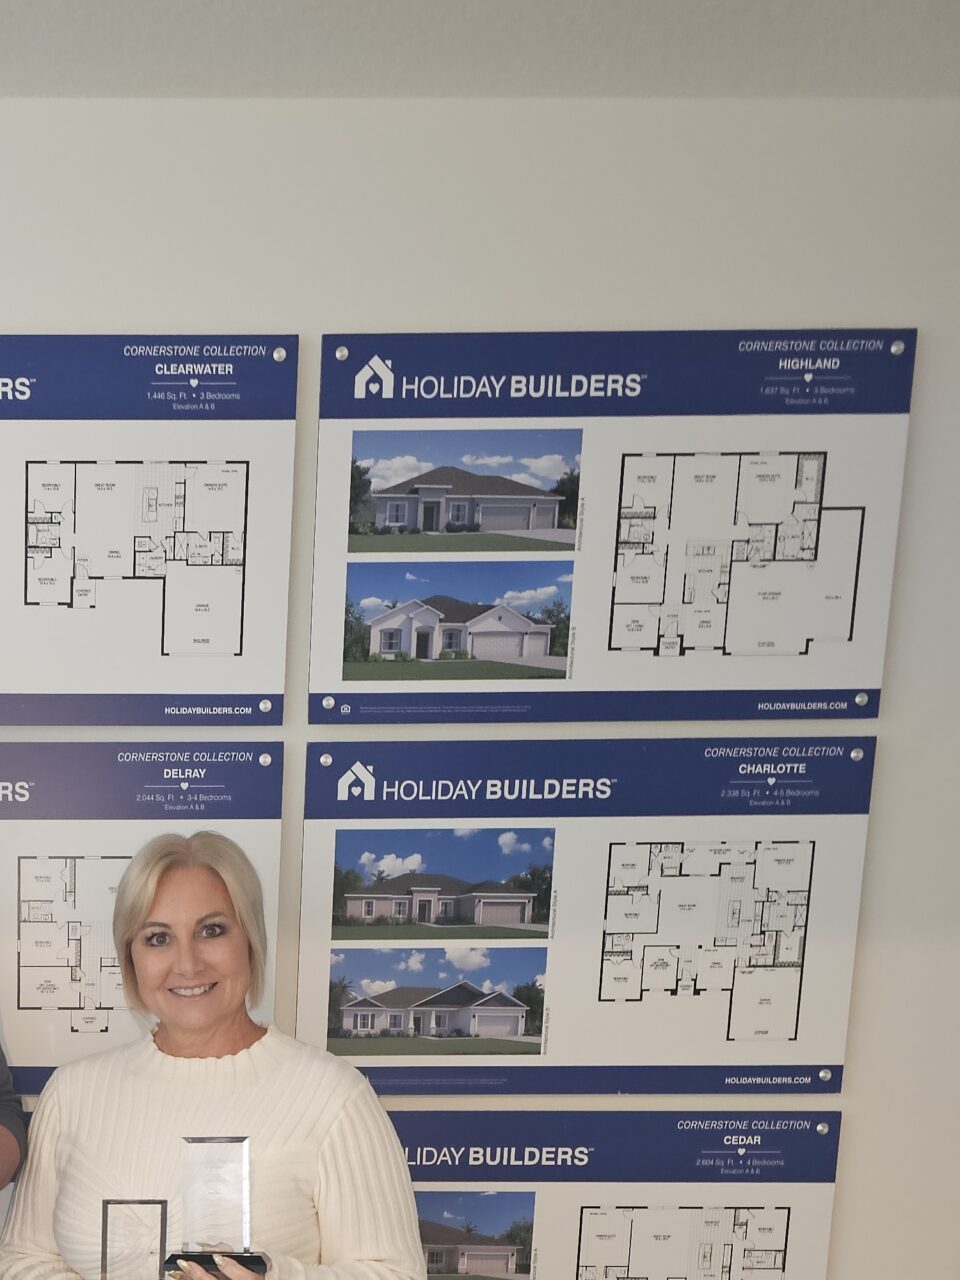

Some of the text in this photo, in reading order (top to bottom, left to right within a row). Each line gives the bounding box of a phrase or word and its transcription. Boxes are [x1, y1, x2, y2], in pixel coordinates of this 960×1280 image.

[124, 345, 267, 357] CORNERSTONE COLLECTION
[738, 340, 884, 352] CORNERSTONE COLLECTION
[155, 364, 234, 375] CLEARWATER
[778, 358, 840, 370] HIGHLAND
[402, 374, 641, 399] HOLIDAY BUILDERS
[200, 392, 205, 400] 3
[206, 392, 241, 400] Bedrooms
[165, 707, 252, 715] HOLIDAYBUILDERS.COM
[758, 702, 848, 710] HOLIDAYBUILDERS.COM
[118, 752, 253, 762] CORNERSTONE COLLECTION
[704, 746, 845, 758] CORNERSTONE COLLECTION
[164, 768, 207, 779] DELRAY
[739, 764, 807, 774] CHARLOTTE
[382, 778, 612, 801] HOLIDAY BUILDERS
[187, 794, 198, 802] 3-4
[200, 794, 232, 802] Bedrooms
[725, 1077, 811, 1085] HOLIDAYBUILDERS.COM
[677, 1120, 811, 1131] CORNERSTONE COLLECTION
[724, 1136, 761, 1145] CEDAR
[405, 1147, 589, 1166] LIDAY BUILDERS
[752, 1158, 784, 1166] Bedrooms
